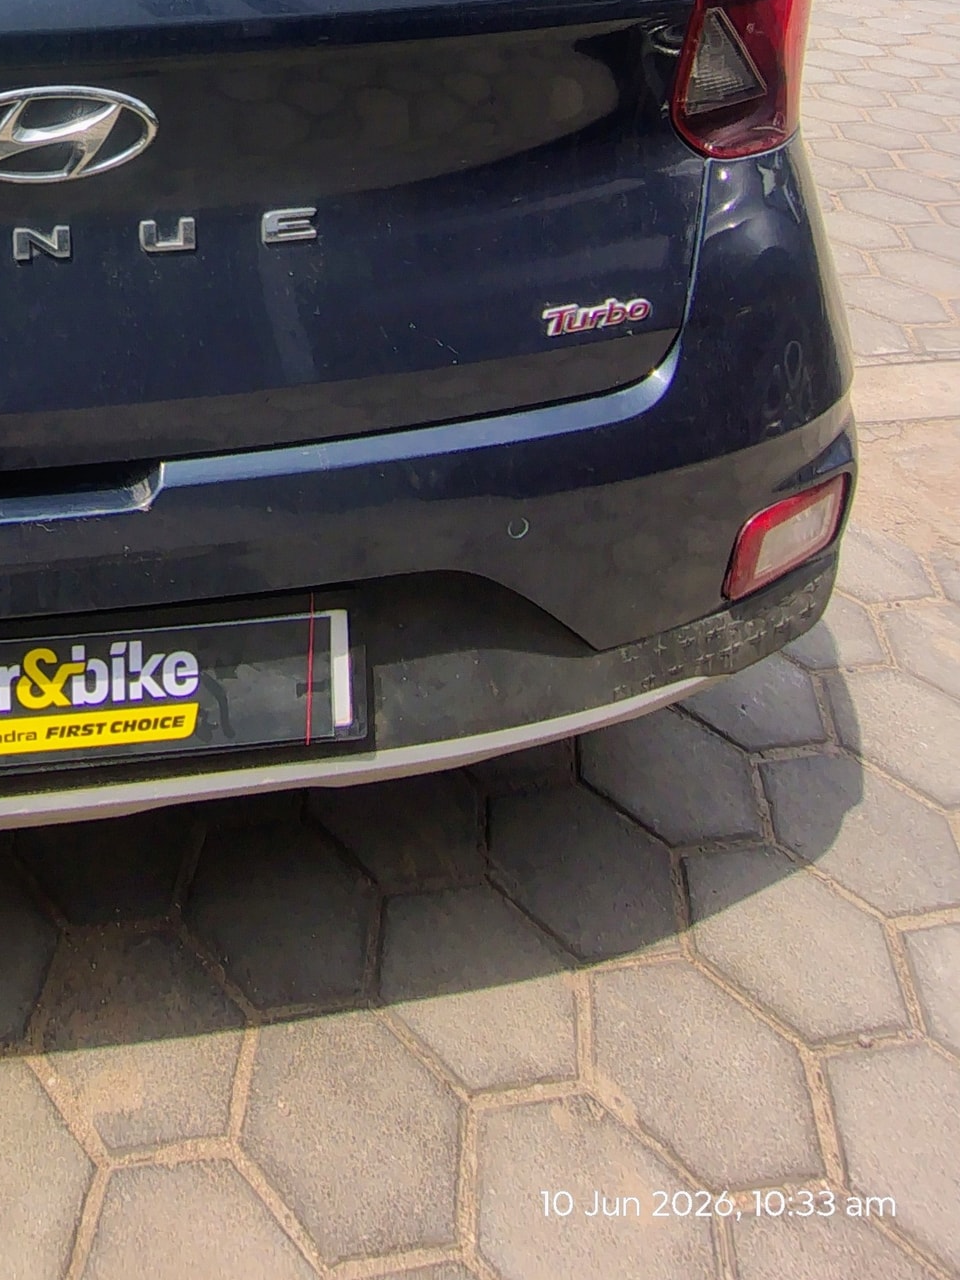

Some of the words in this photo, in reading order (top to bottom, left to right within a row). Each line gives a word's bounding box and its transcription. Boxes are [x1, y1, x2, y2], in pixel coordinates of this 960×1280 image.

[542, 297, 652, 337] Turbo
[45, 722, 106, 740] FIRST
[109, 715, 186, 734] CHOICE
